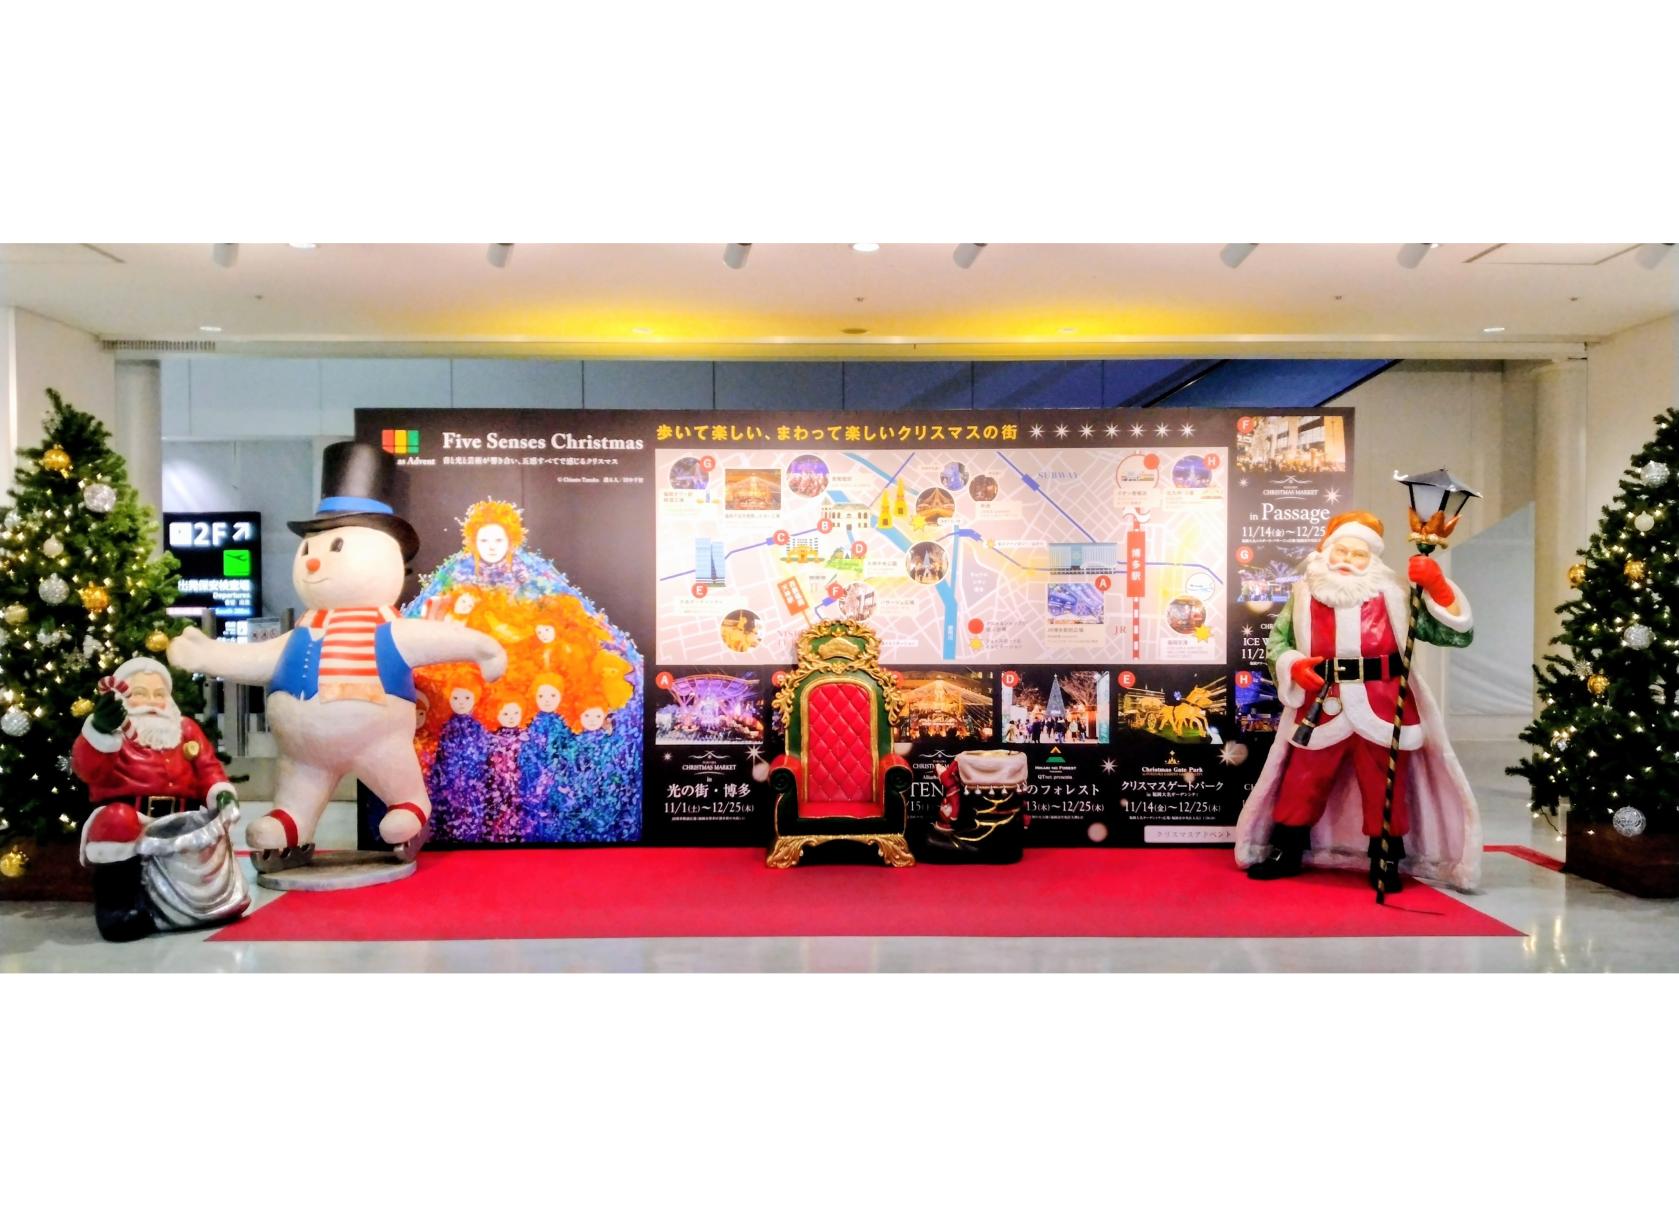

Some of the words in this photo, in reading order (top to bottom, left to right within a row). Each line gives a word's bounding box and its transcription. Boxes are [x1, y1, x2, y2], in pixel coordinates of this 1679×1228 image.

[656, 424, 1018, 441] 歩いて楽しい、まわって楽しいクリスマスの街
[442, 432, 481, 449] Five
[486, 432, 546, 449] Senses
[550, 433, 644, 449] Christmas
[407, 456, 436, 465] Advent
[1208, 456, 1216, 466] H
[1038, 471, 1078, 480] SUBWAY
[1250, 512, 1258, 521] in
[1262, 503, 1330, 524] Passage
[193, 522, 227, 546] 2F
[855, 543, 863, 553] D
[1240, 549, 1249, 559] G
[696, 585, 703, 595] E
[832, 586, 839, 596] F
[212, 592, 251, 601] Departures
[1243, 638, 1260, 646] ICE
[660, 675, 668, 685] A
[1006, 674, 1014, 683] D
[1123, 674, 1131, 684] E
[1240, 675, 1248, 684] H
[667, 783, 751, 798] 光の街・博多
